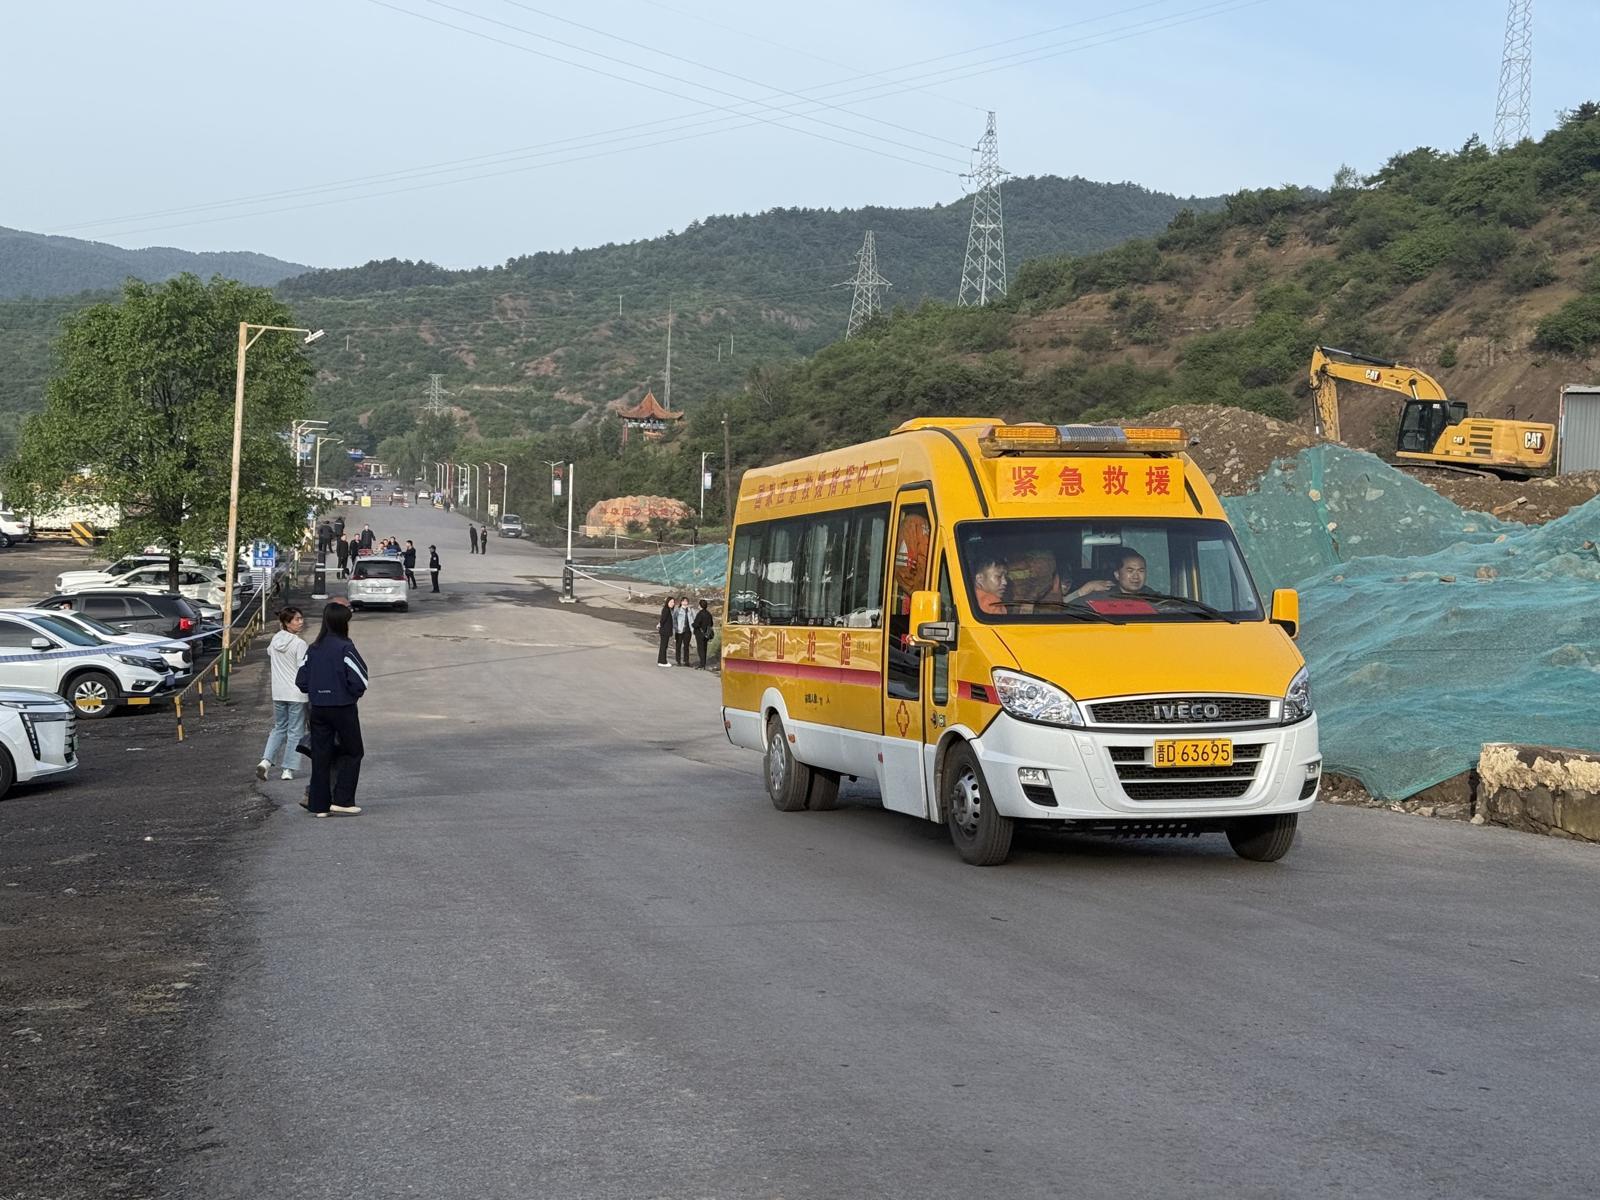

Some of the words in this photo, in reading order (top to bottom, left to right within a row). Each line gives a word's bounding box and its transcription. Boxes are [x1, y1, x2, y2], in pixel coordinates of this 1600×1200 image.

[1365, 369, 1380, 380] CAT
[1452, 436, 1464, 444] CAT
[1524, 431, 1543, 449] CAT
[1011, 464, 1172, 498] 紧急救援
[258, 541, 270, 558] P
[1153, 703, 1220, 720] IVECO
